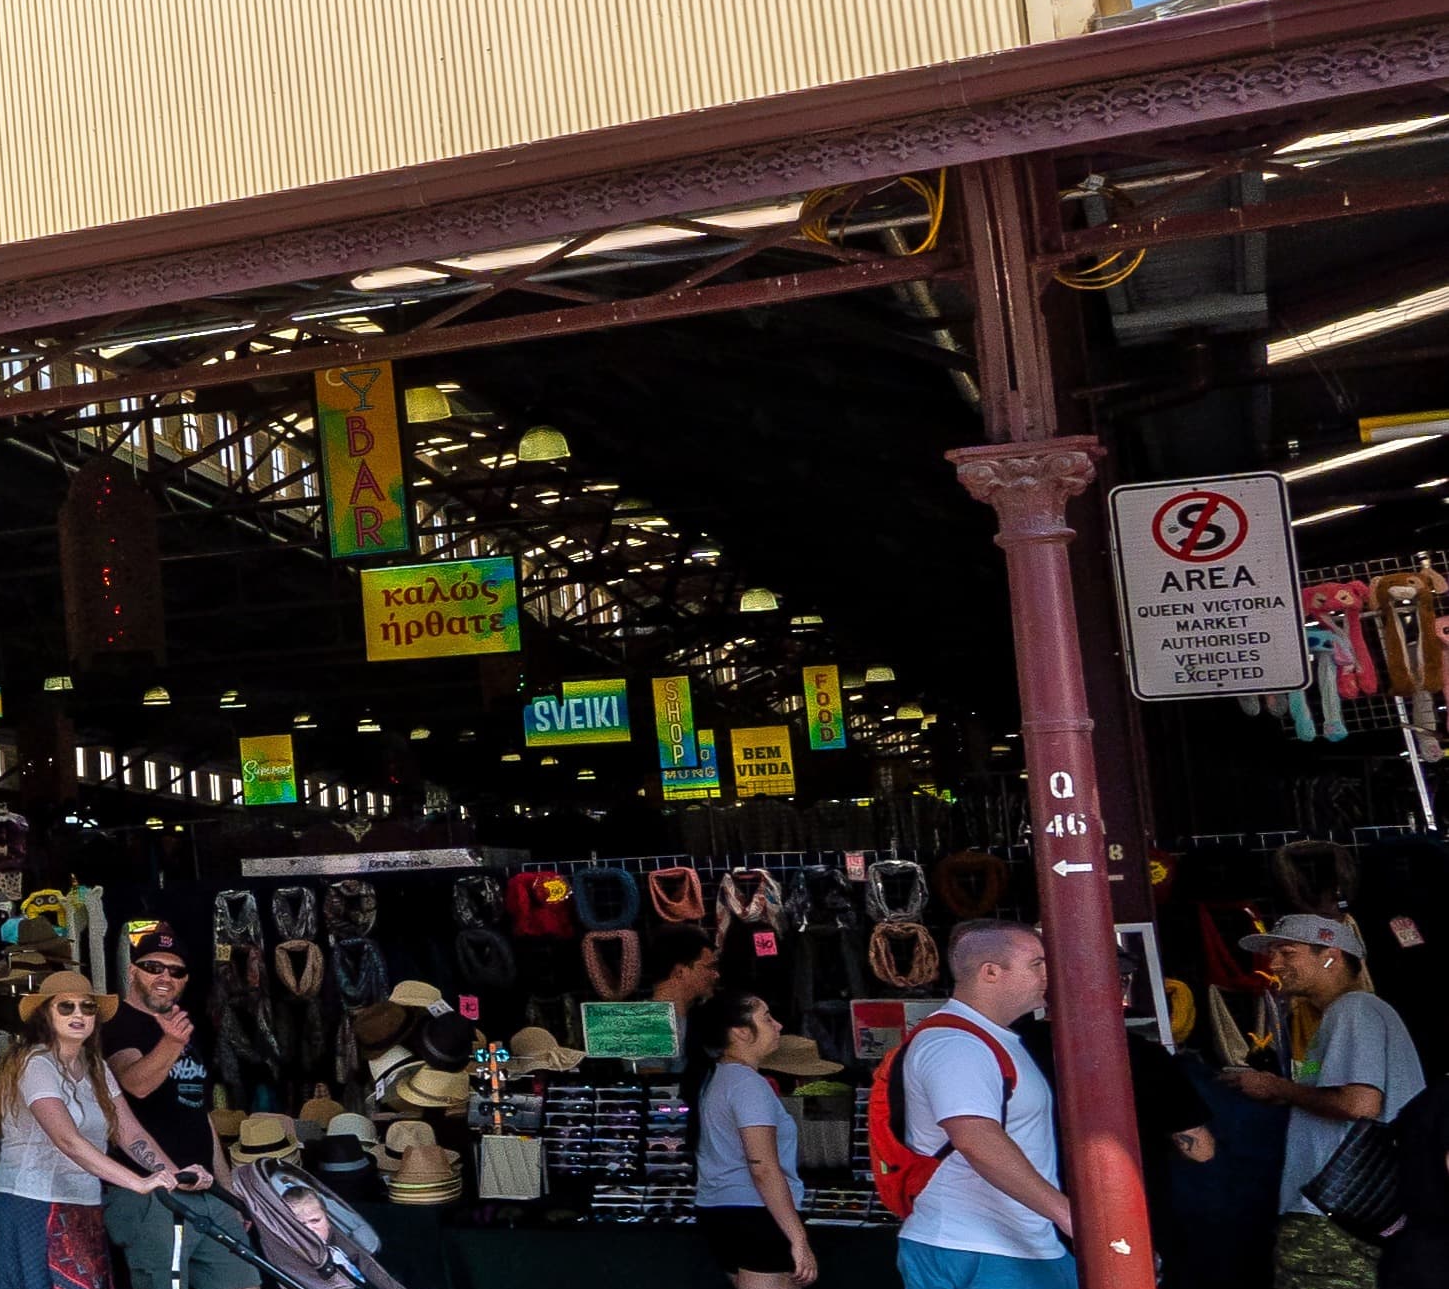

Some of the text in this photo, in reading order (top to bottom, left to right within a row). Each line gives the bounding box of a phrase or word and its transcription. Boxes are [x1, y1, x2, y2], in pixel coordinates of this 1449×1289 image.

[346, 416, 385, 548] BAR
[381, 572, 499, 607] καλώς
[1160, 565, 1255, 593] AREA
[1137, 596, 1285, 618] QUEEN VICTORIA
[1176, 616, 1248, 632] MARKET
[1161, 632, 1271, 650] AUTHORISED
[1175, 650, 1260, 666] VEHICLES
[1175, 667, 1264, 683] EXCEPTED
[534, 695, 620, 732] SVEIKI
[814, 673, 835, 742] FOOD
[665, 681, 685, 765] SHOP
[742, 745, 782, 760] BEM
[737, 761, 792, 776] VINDA
[1045, 813, 1087, 838] 46
